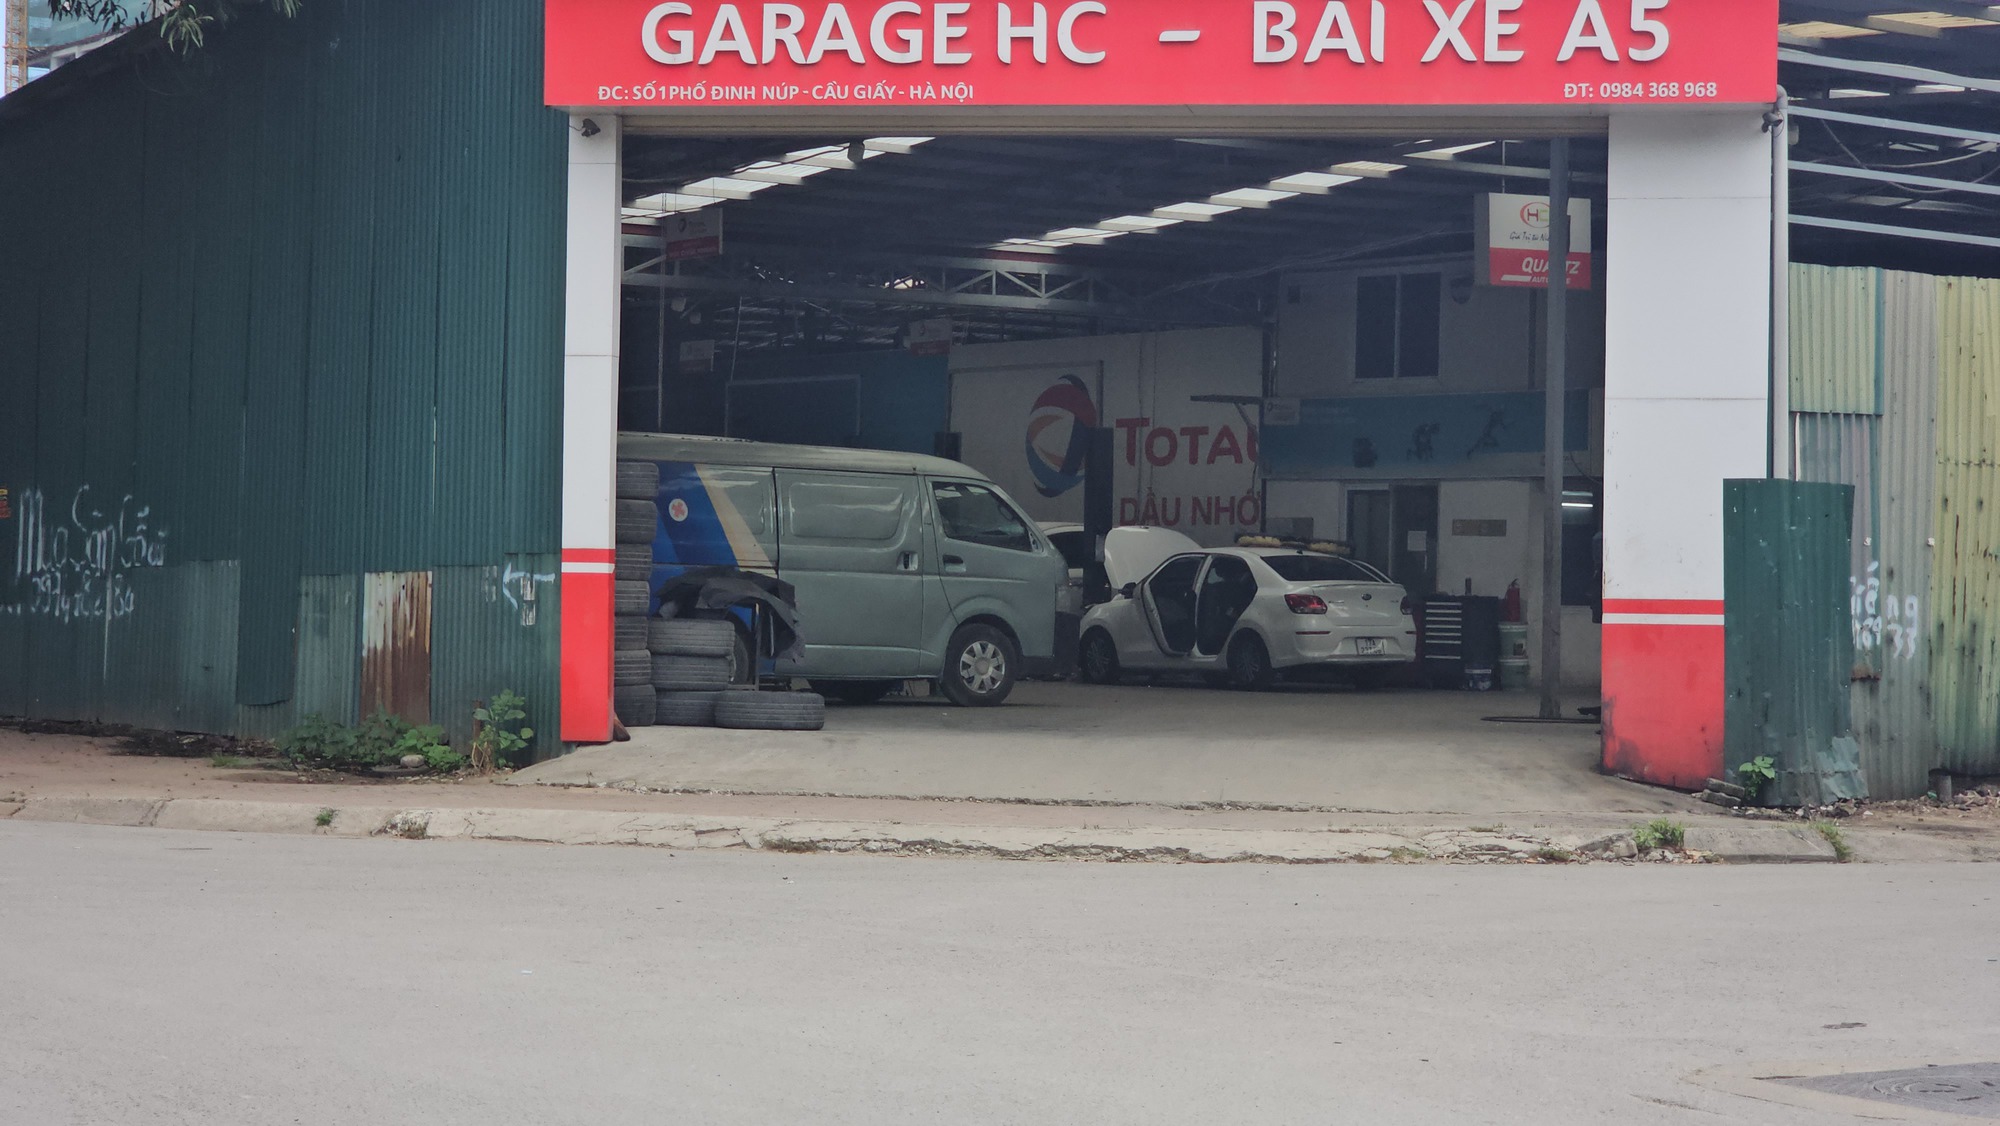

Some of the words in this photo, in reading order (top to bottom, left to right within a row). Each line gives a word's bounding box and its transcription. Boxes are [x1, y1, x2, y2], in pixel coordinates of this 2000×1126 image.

[641, 0, 973, 65] GARAGE
[997, 0, 1107, 65] HC
[1420, 0, 1526, 63] XE
[1556, 0, 1671, 63] A5
[710, 85, 756, 100] ĐINH
[762, 81, 799, 100] NÚP
[811, 80, 849, 100] CẦU
[853, 79, 897, 100] GIẤY
[909, 81, 937, 100] HÀ
[941, 81, 974, 103] NỘI
[1563, 82, 1594, 98] ĐT:
[1600, 82, 1644, 98] 0984
[1648, 81, 1680, 98] 368
[1684, 81, 1718, 98] 968
[1521, 256, 1581, 274] QUATZ
